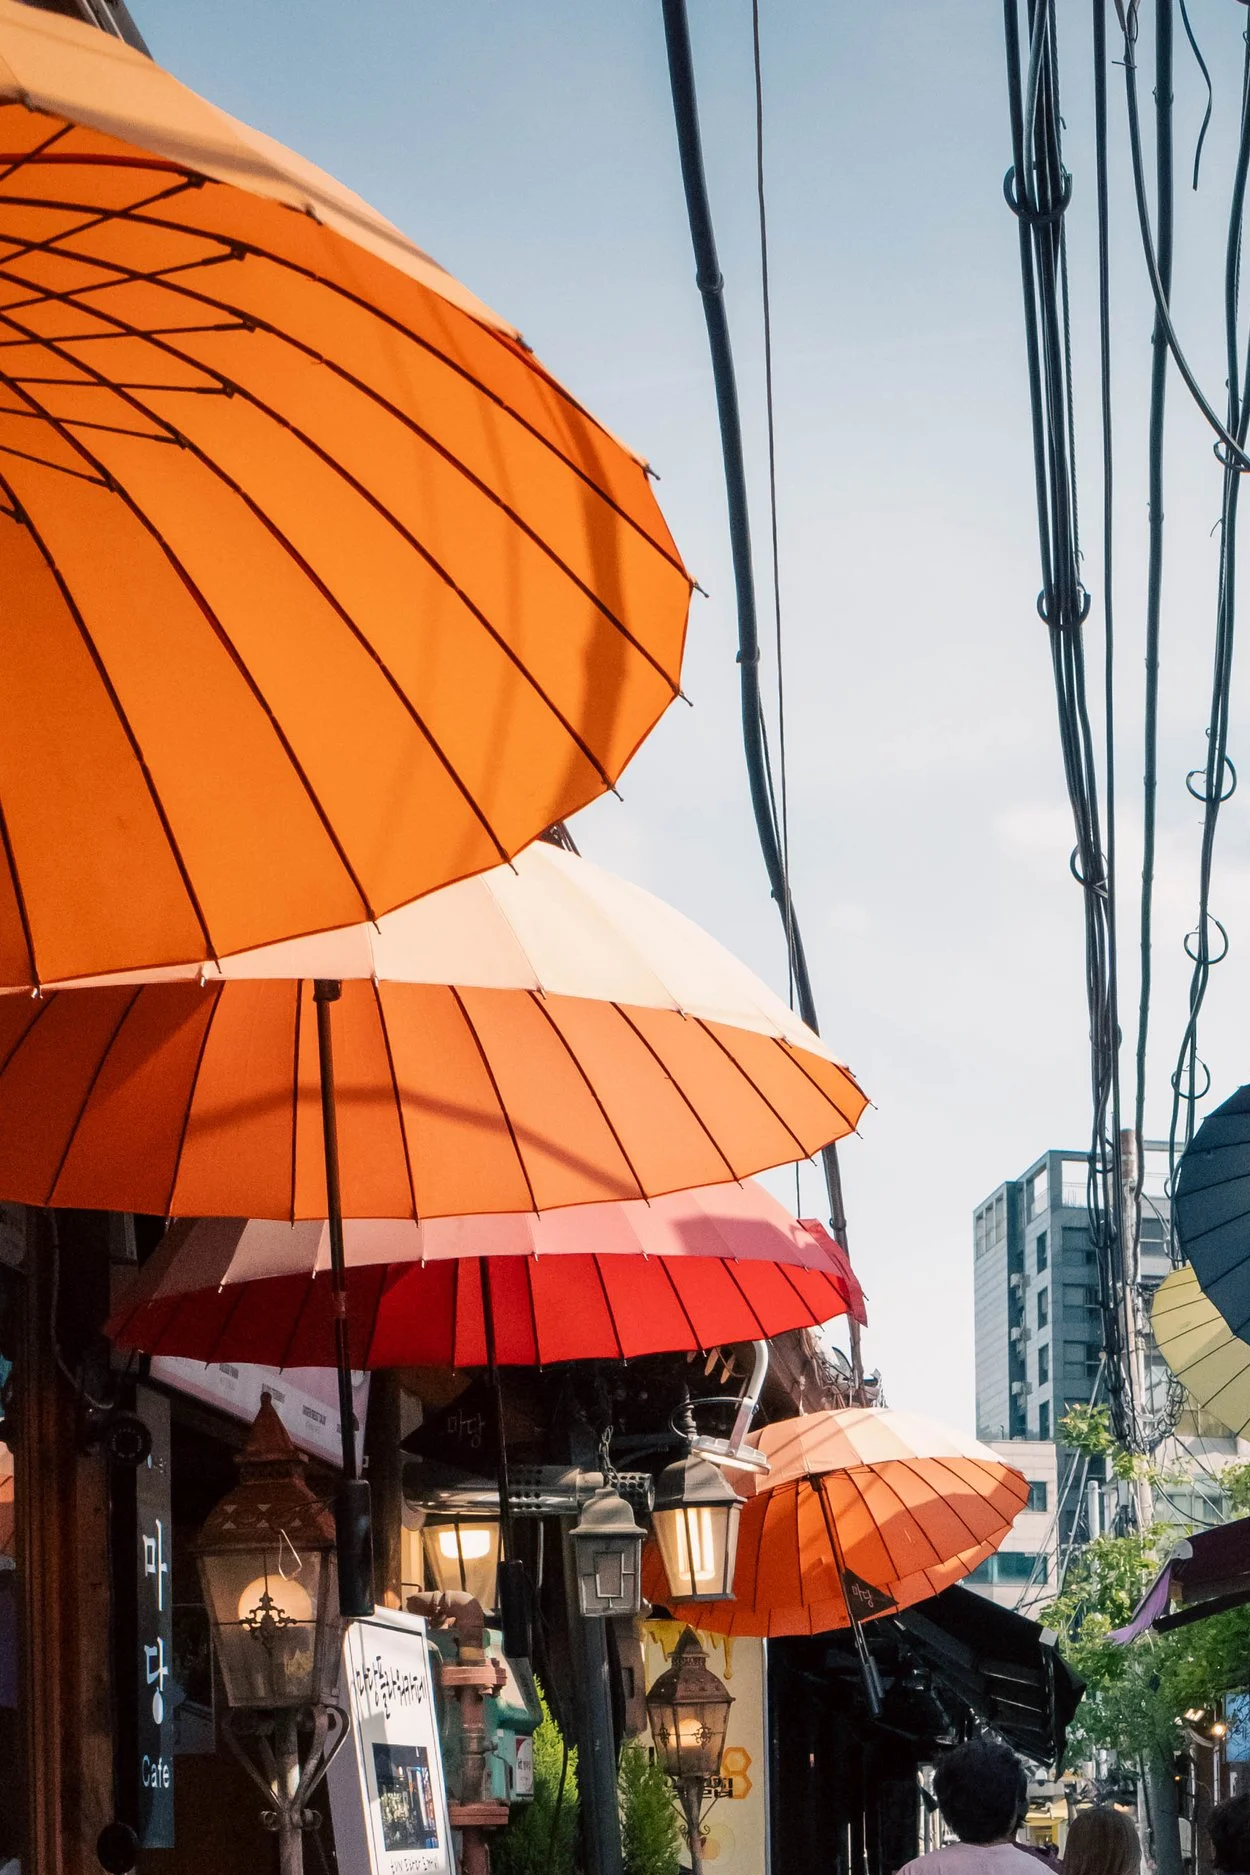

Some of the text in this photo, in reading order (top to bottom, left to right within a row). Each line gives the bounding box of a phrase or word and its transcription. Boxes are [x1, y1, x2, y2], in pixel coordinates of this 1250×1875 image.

[447, 1409, 486, 1448] 마당
[851, 1583, 874, 1608] 마당
[142, 1518, 168, 1725] 마당
[142, 1754, 170, 1789] Cafe
